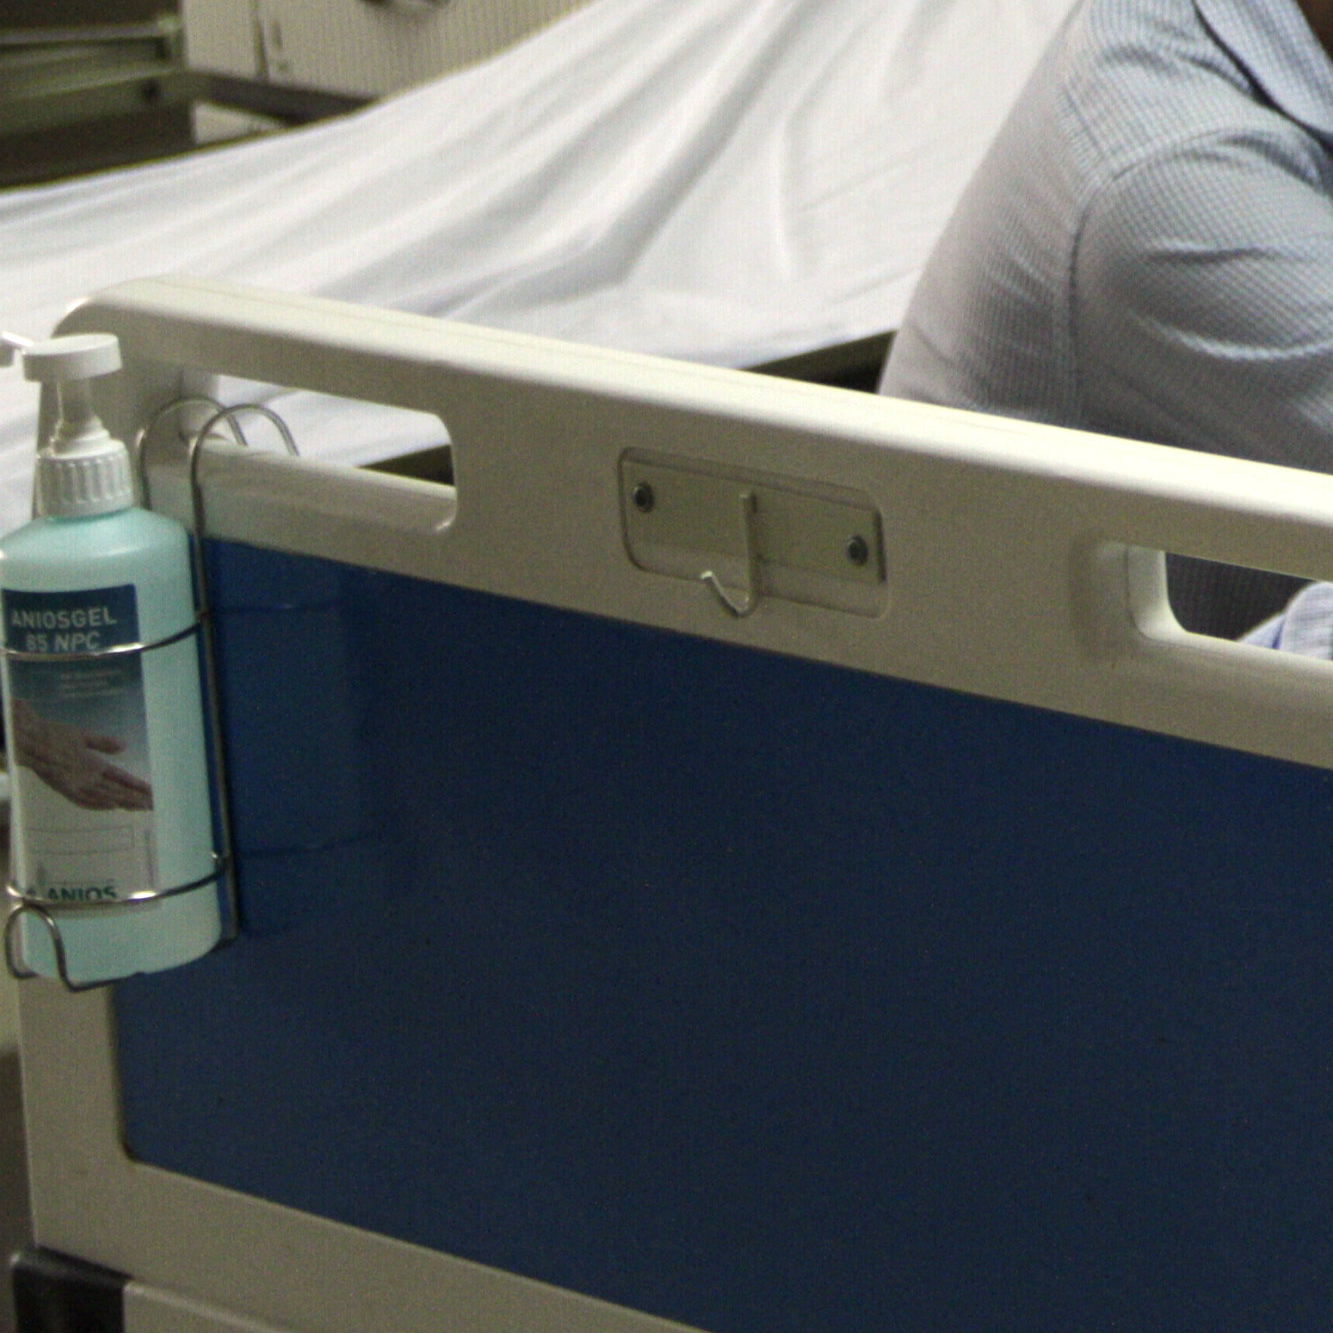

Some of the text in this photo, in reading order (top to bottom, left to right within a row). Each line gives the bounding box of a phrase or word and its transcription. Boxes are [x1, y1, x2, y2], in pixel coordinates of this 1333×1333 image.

[11, 606, 117, 629] ANIOSGEL
[25, 630, 101, 653] 85 NPC
